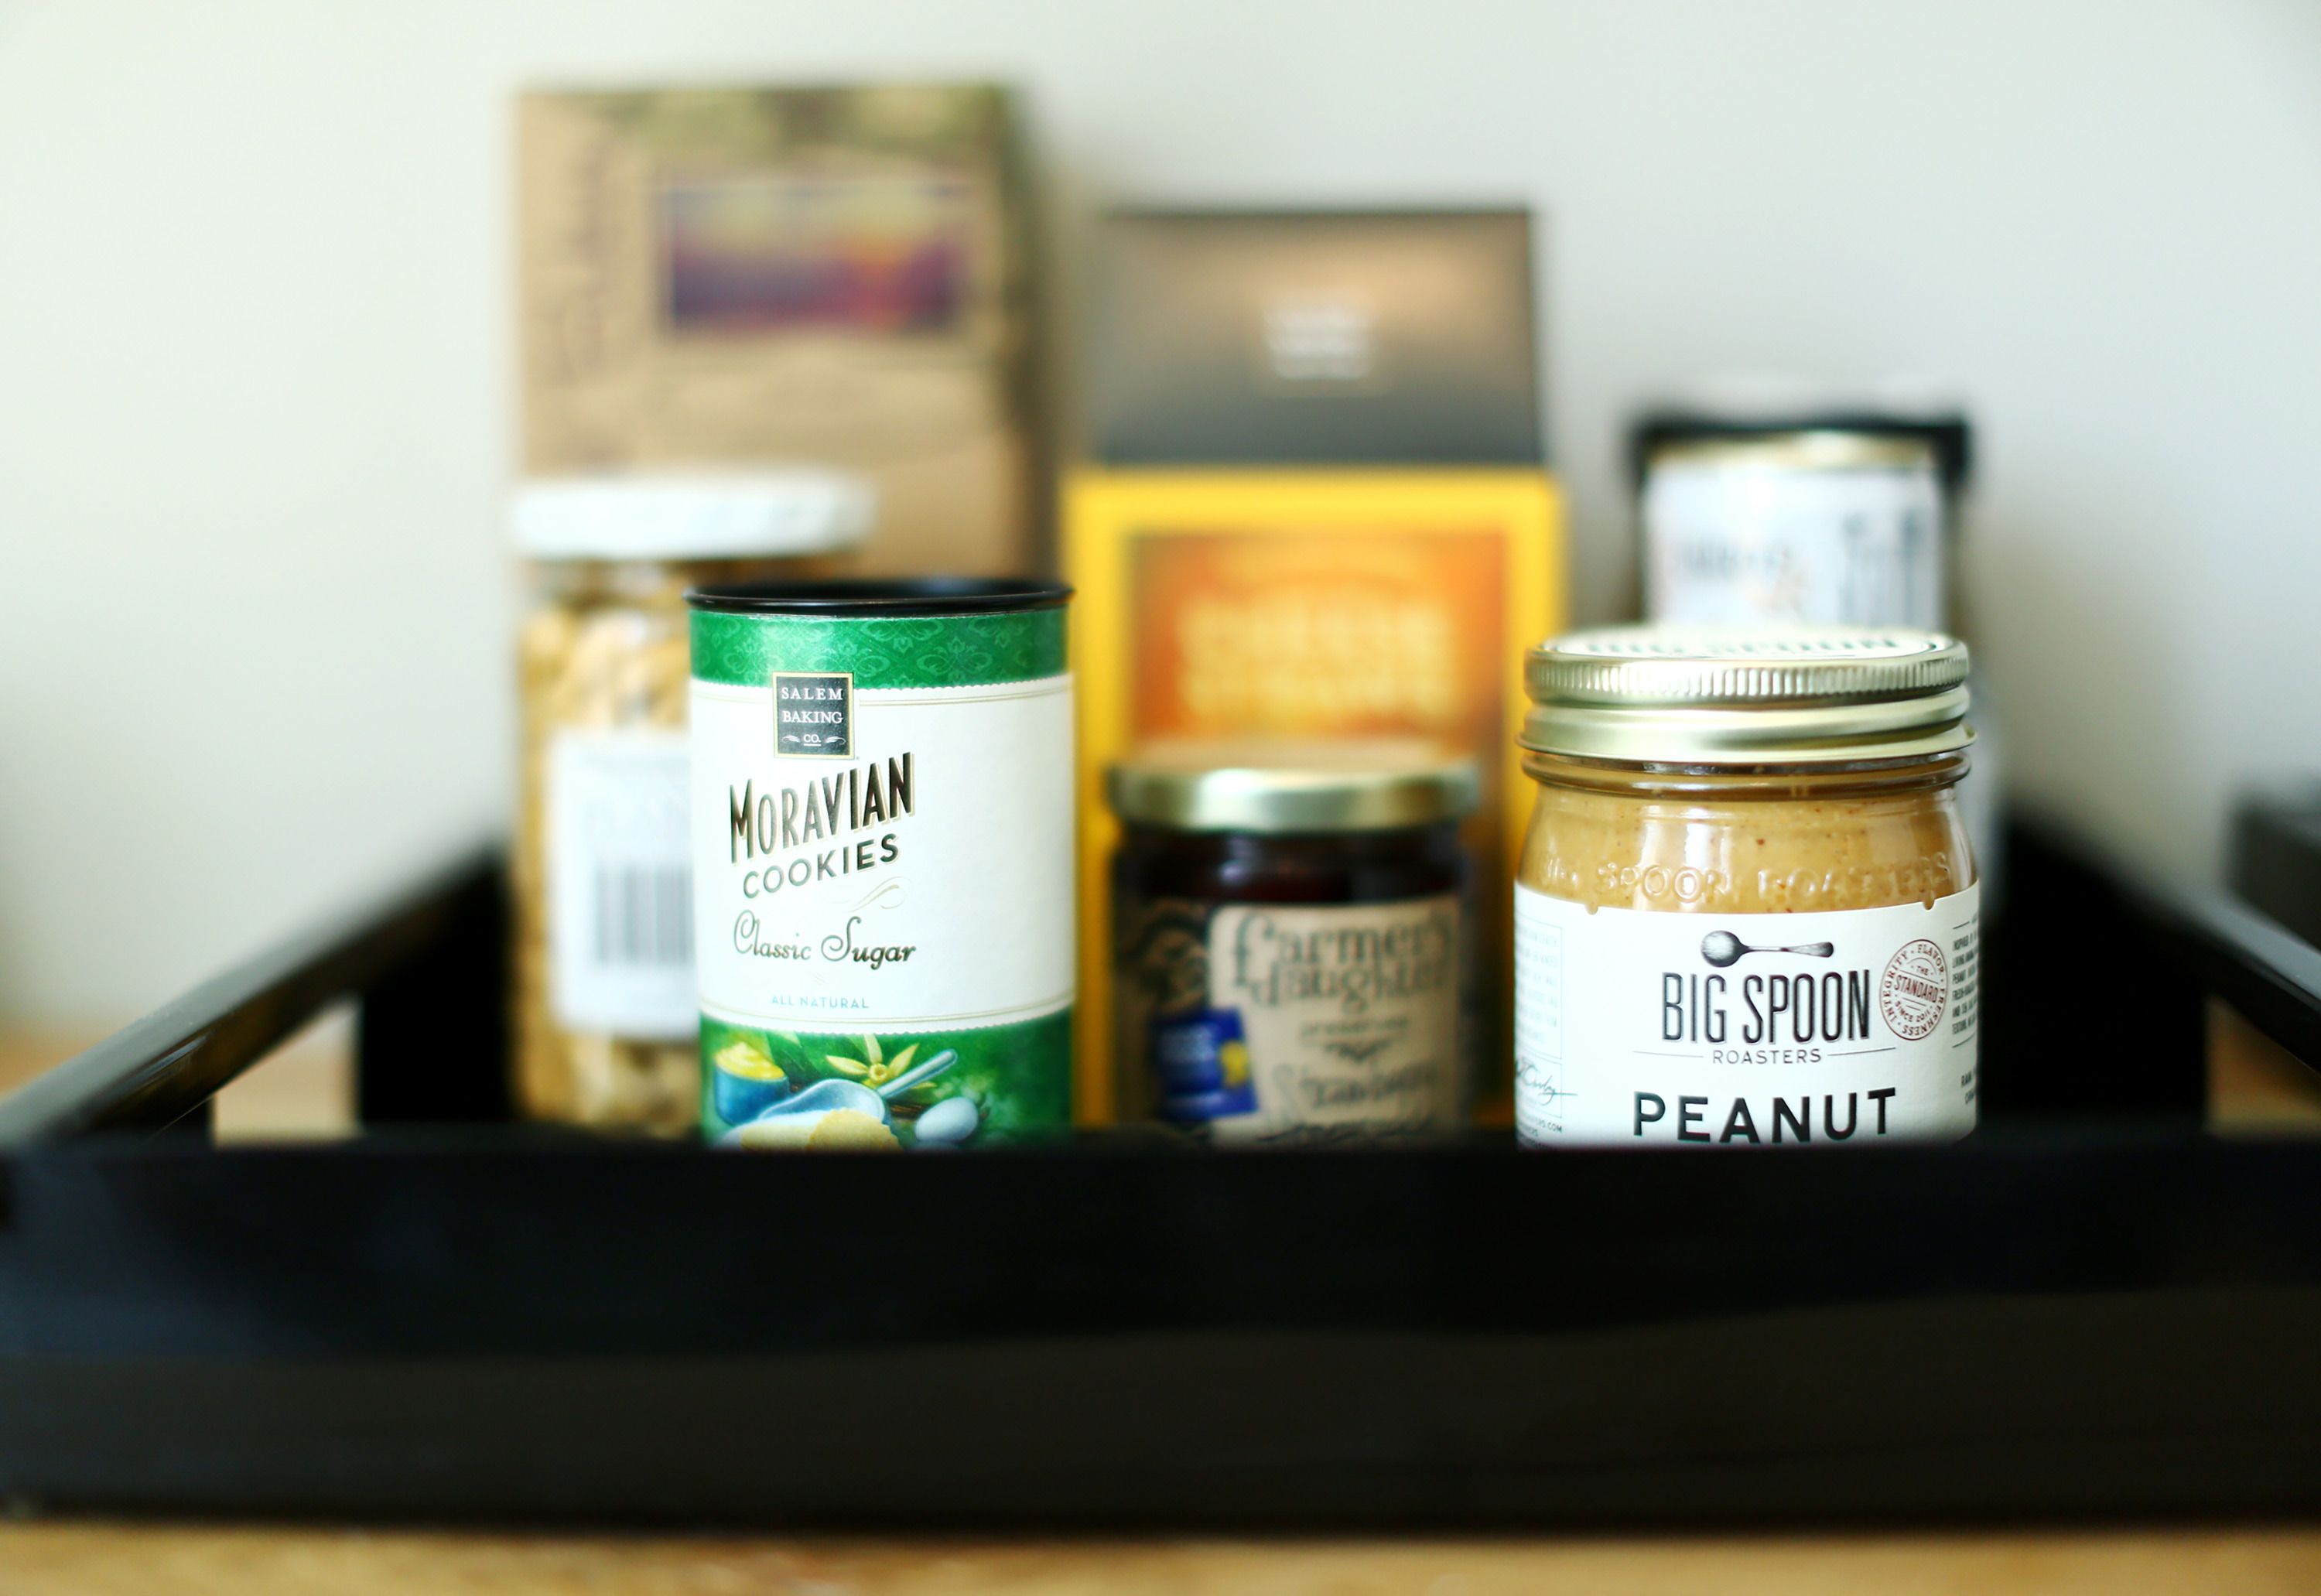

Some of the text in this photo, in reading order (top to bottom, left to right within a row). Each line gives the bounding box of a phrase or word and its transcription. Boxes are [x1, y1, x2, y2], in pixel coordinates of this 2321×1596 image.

[781, 687, 843, 700] SALEM
[782, 710, 844, 724] BAKING
[803, 733, 822, 743] CO.
[730, 751, 915, 865] MORAVIAN
[743, 833, 900, 900] COOKIES
[733, 909, 917, 971] Classic Sugar
[1917, 944, 1944, 973] FLAVOR
[1882, 951, 1908, 1023] INTEGRITY
[1894, 975, 1939, 1003] STANDARD
[771, 994, 870, 1009] ALL NATURAL
[1661, 969, 1870, 1044] BIG SPOON
[1895, 1000, 1913, 1022] SINCE
[1712, 1048, 1822, 1065] ROASTERS
[1633, 1086, 1896, 1143] PEANUT
